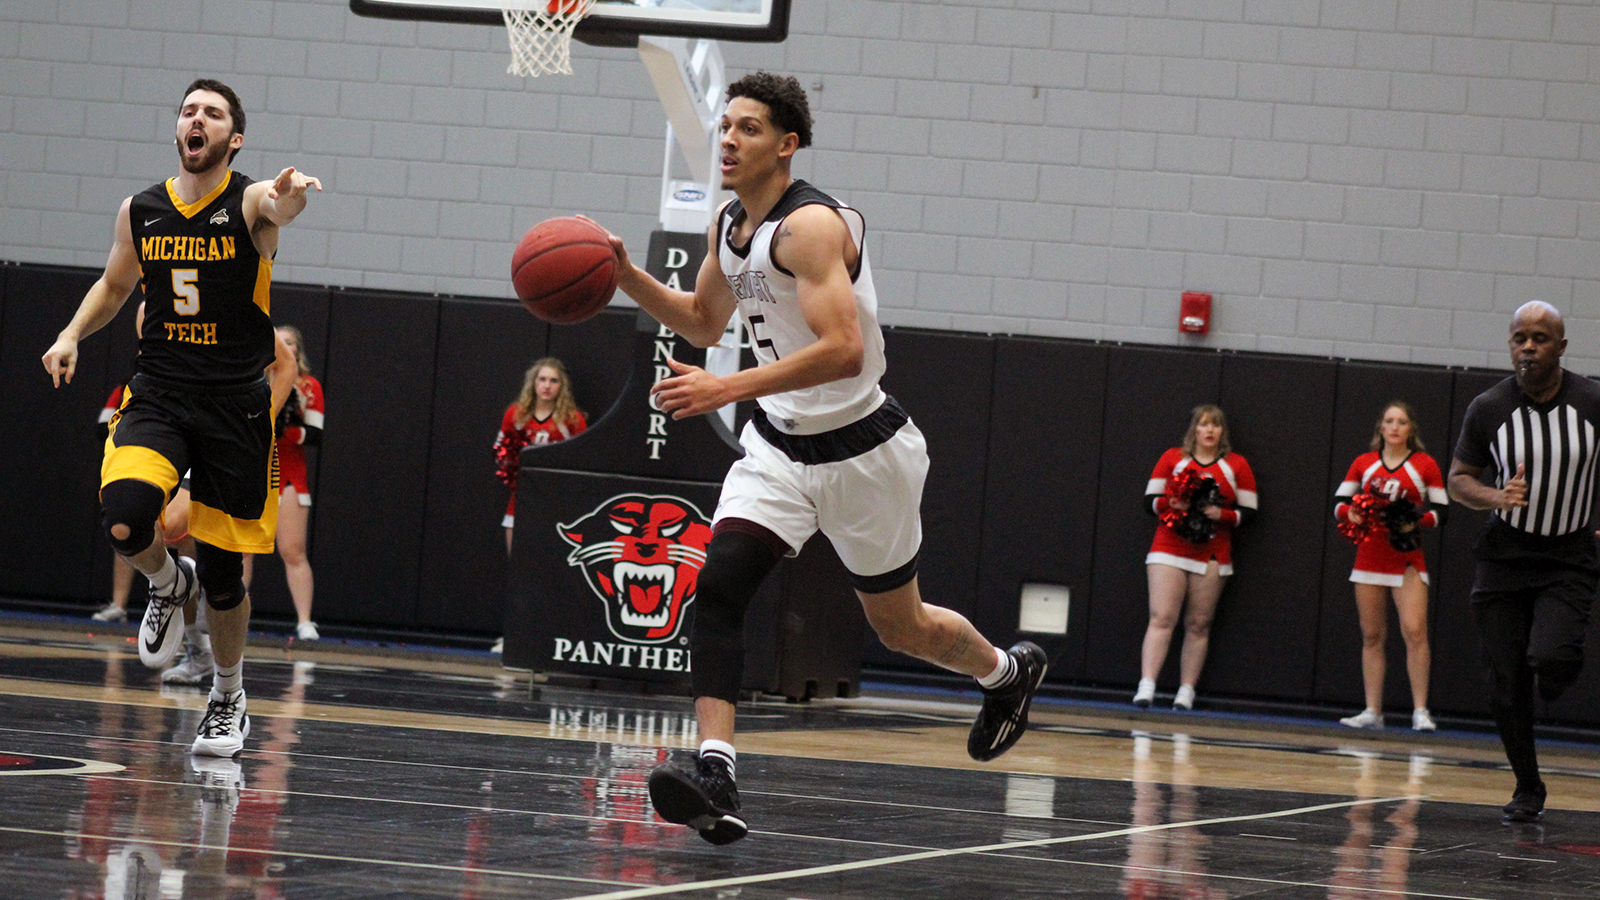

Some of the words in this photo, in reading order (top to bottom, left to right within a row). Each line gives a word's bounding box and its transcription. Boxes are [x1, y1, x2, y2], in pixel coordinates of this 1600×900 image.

[142, 236, 236, 261] MICHIGAN
[171, 268, 200, 316] 5
[163, 322, 218, 345] TECH
[552, 638, 692, 673] PANTHE
